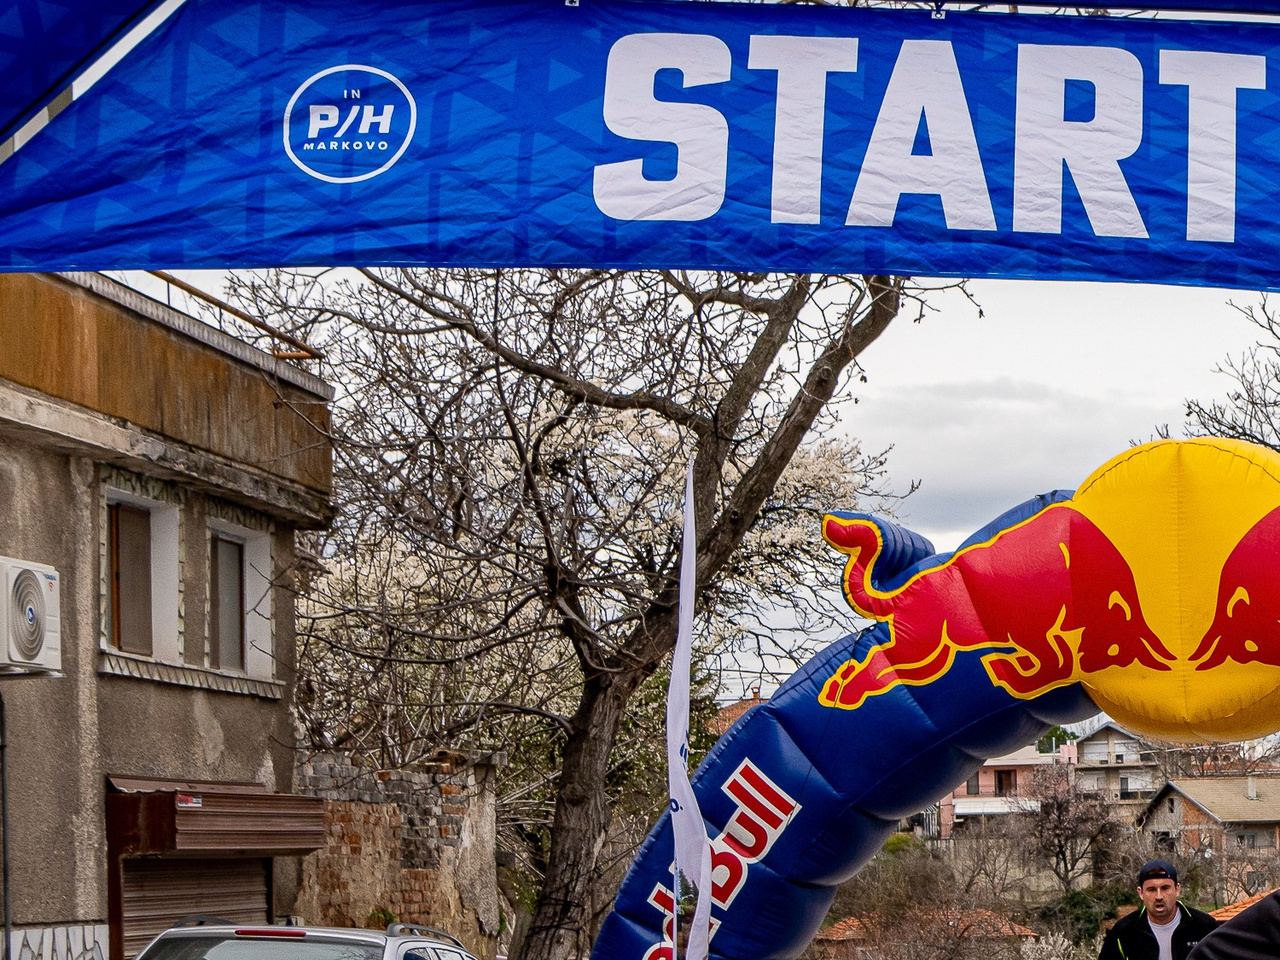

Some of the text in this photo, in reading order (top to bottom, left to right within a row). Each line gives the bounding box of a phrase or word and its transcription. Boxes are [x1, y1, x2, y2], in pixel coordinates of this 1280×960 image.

[343, 89, 361, 99] IN
[307, 104, 395, 139] P/H
[593, 32, 1267, 243] START
[303, 141, 389, 151] MARKOVO
[710, 761, 799, 907] Bull
